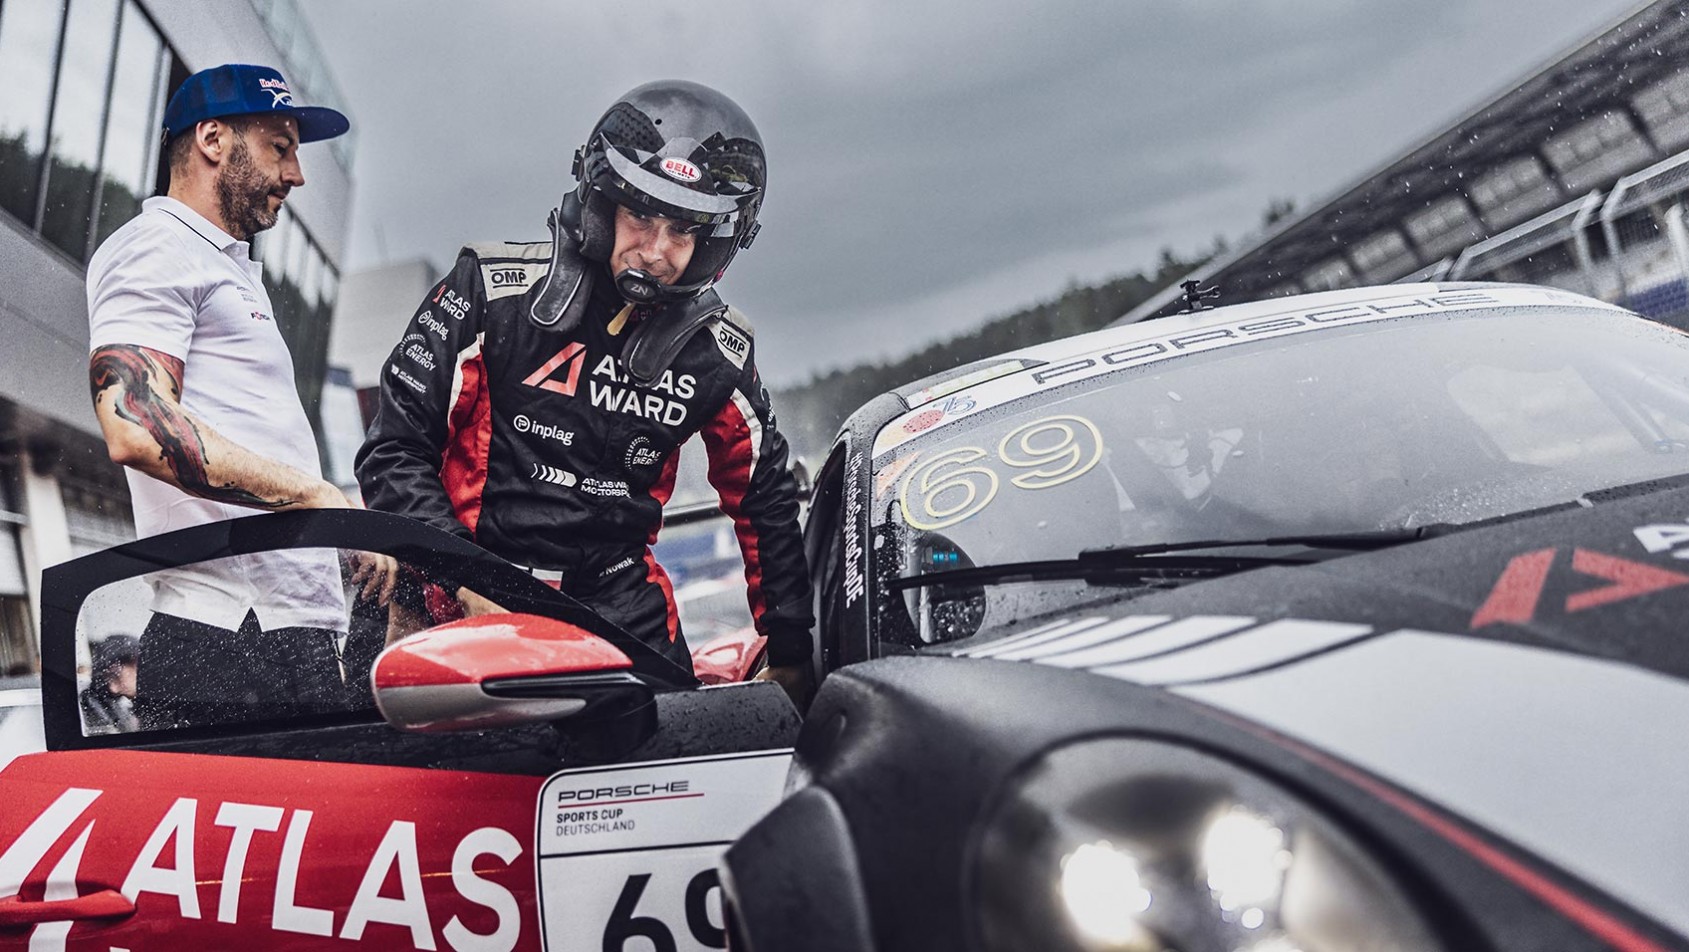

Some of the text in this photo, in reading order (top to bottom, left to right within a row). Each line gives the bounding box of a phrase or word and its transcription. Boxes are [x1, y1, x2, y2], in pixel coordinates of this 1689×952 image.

[666, 160, 695, 177] BELL
[491, 271, 527, 284] OMP
[720, 330, 745, 352] OMP
[1032, 292, 1499, 384] PORSCHE
[405, 348, 436, 371] ENERGY
[410, 343, 434, 361] ATLAS
[592, 354, 697, 399] AAS
[589, 379, 688, 427] WARD
[531, 420, 575, 446] inplag
[899, 413, 1104, 531] 69
[558, 780, 689, 802] PORSCHE
[556, 808, 624, 824] SPORTS CUP
[556, 819, 636, 837] DEUTSCHLAND
[120, 797, 524, 952] ATLAS
